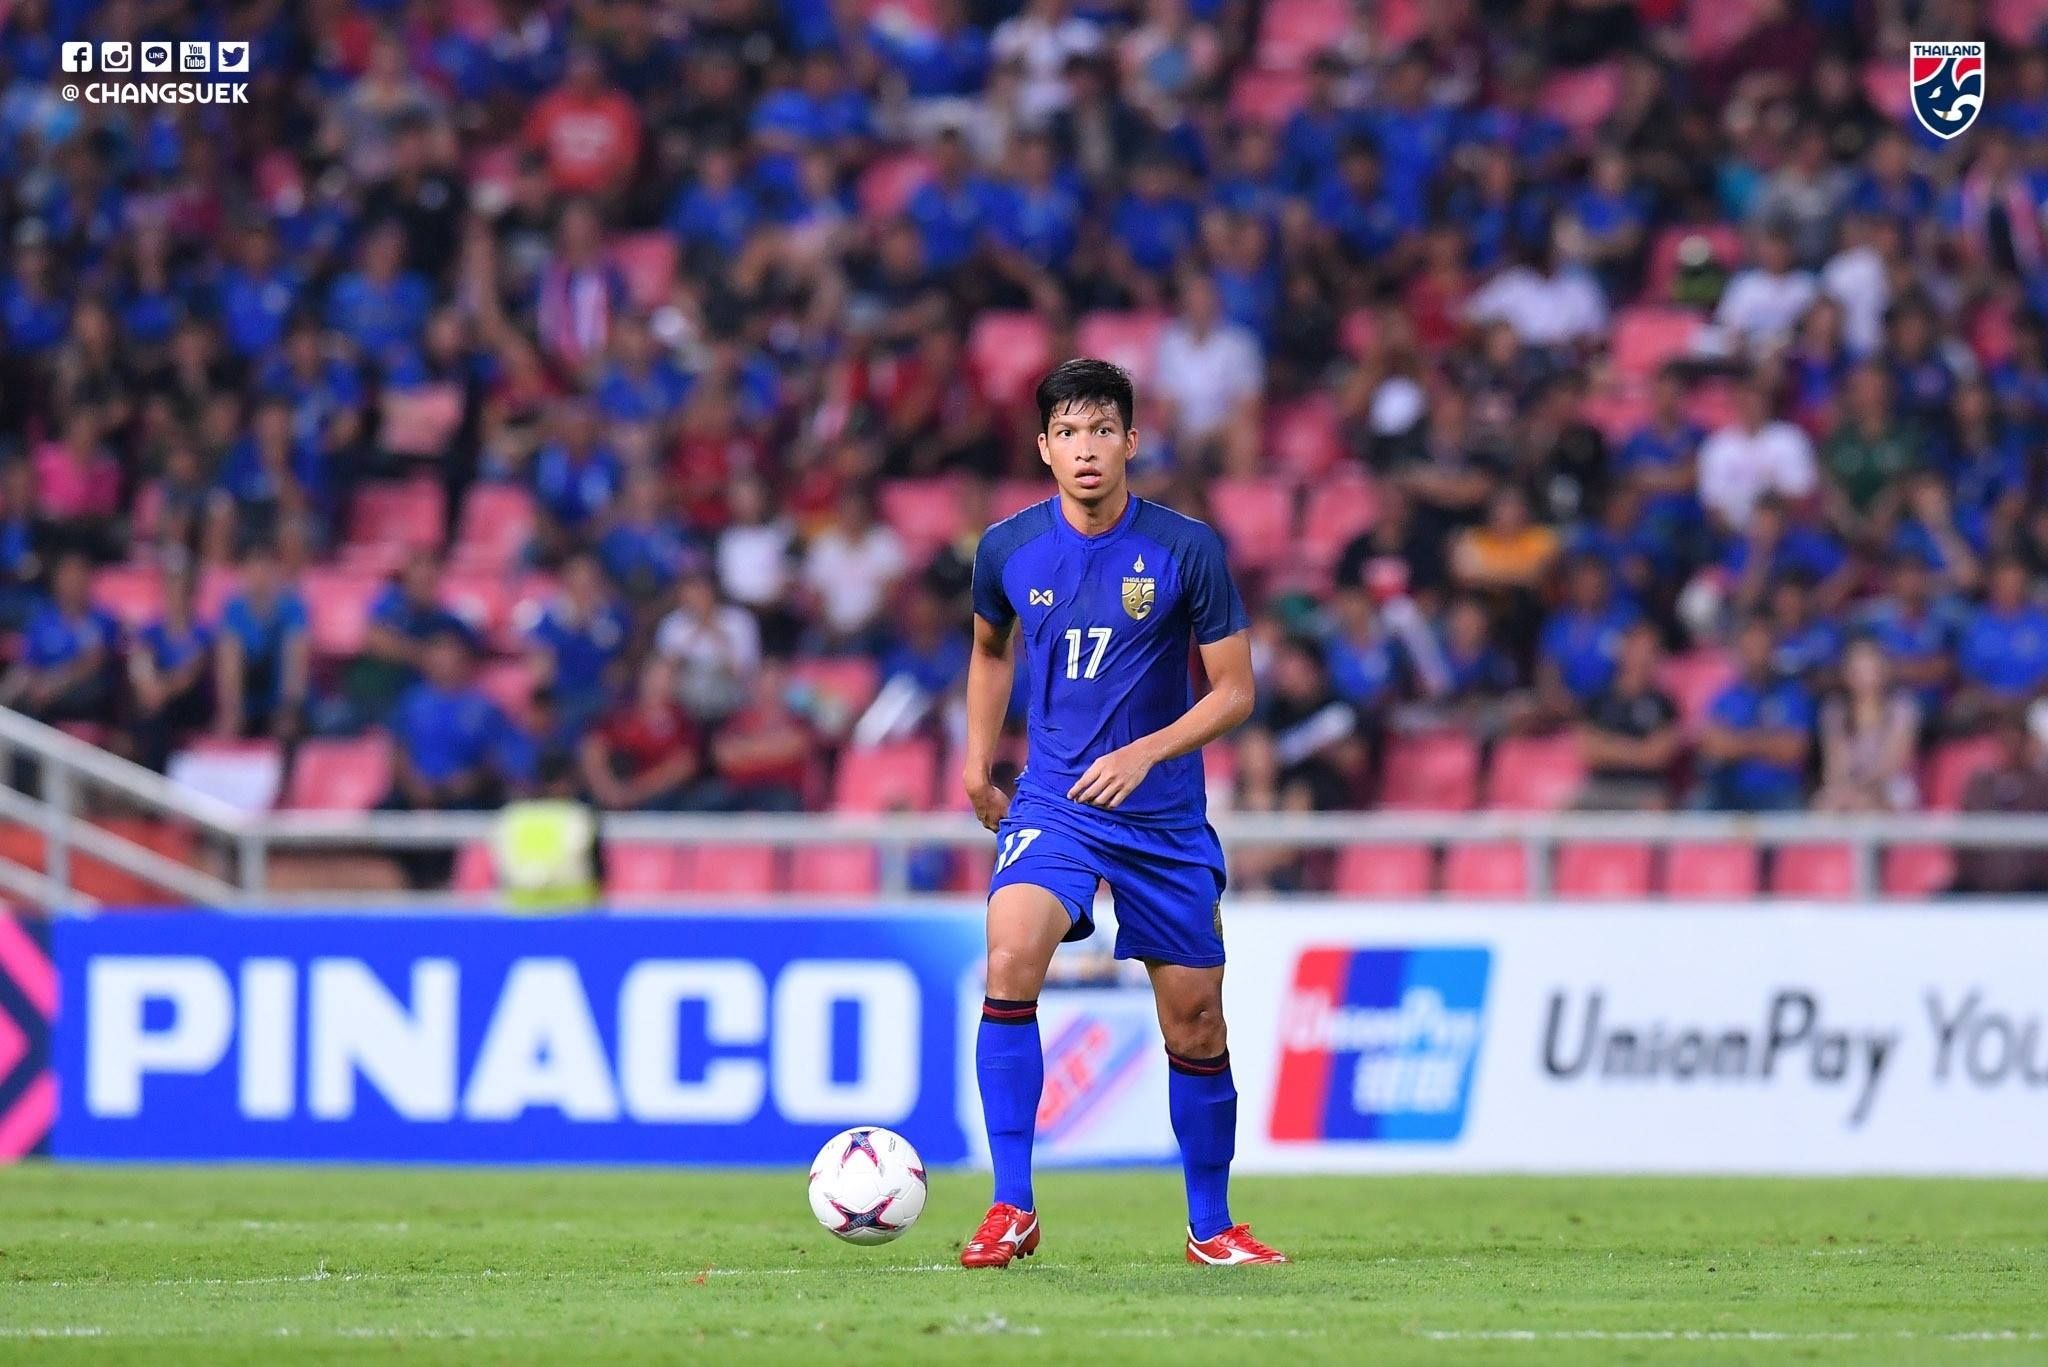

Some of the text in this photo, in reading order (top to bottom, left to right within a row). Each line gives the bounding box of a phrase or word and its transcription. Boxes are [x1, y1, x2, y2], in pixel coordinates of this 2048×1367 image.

[1064, 627, 1113, 680] 17
[995, 828, 1042, 874] 17
[84, 955, 922, 1124] PINACO
[1541, 988, 1898, 1128] UnionPay
